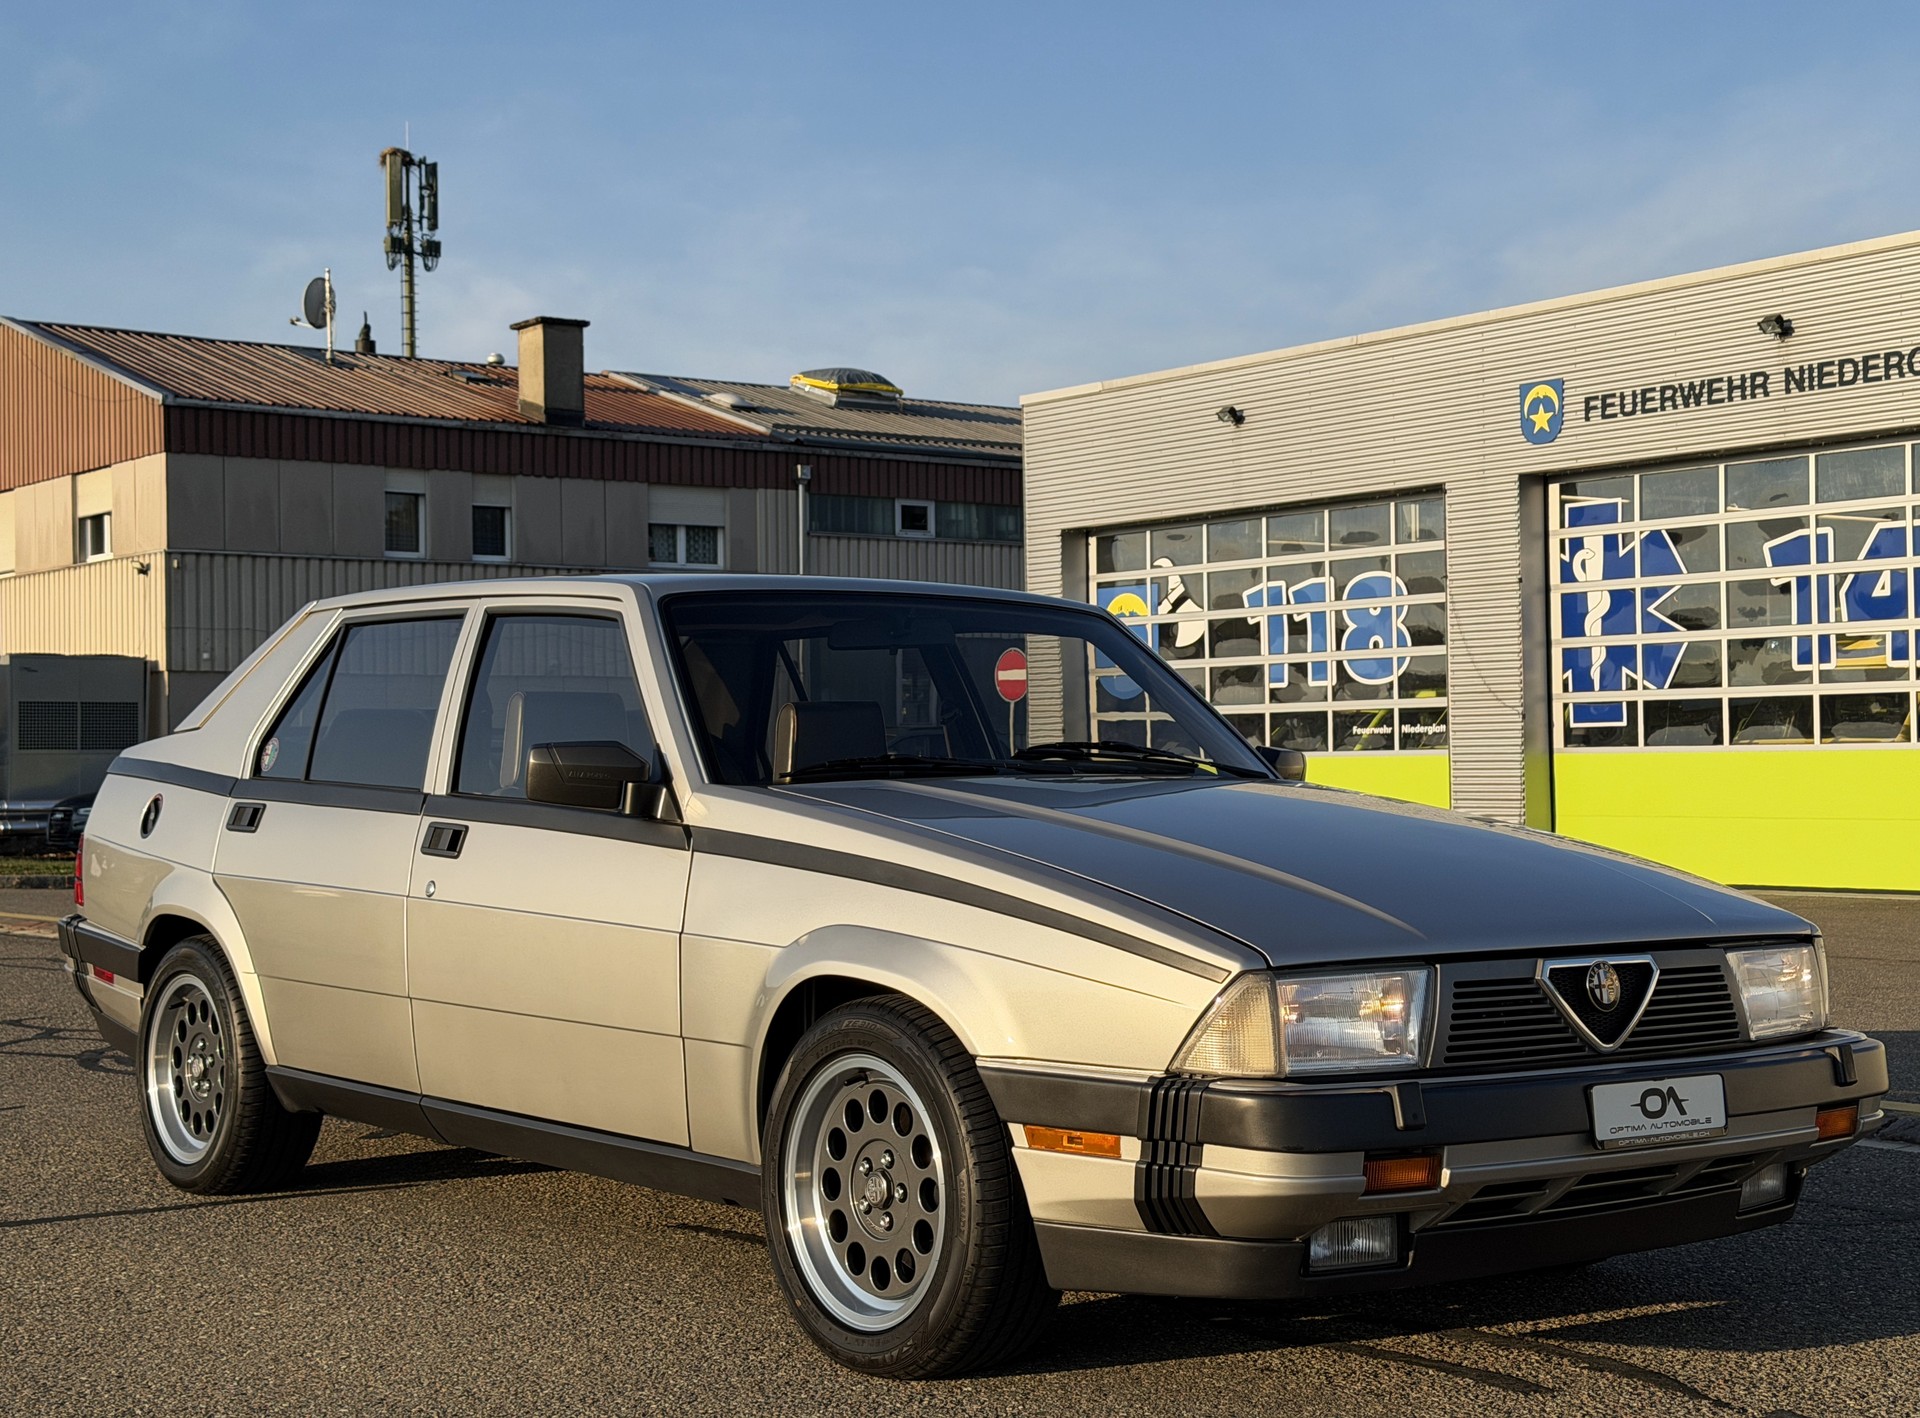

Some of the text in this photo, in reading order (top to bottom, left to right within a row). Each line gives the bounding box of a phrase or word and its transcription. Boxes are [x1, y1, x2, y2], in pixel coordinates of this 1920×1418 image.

[1584, 371, 1770, 422] FEUERWEHR
[1242, 570, 1412, 689] 118
[1352, 724, 1447, 735] Feuerwehr Niederglatt
[1609, 1117, 1712, 1134] OPTIMA AUTOMOBILE
